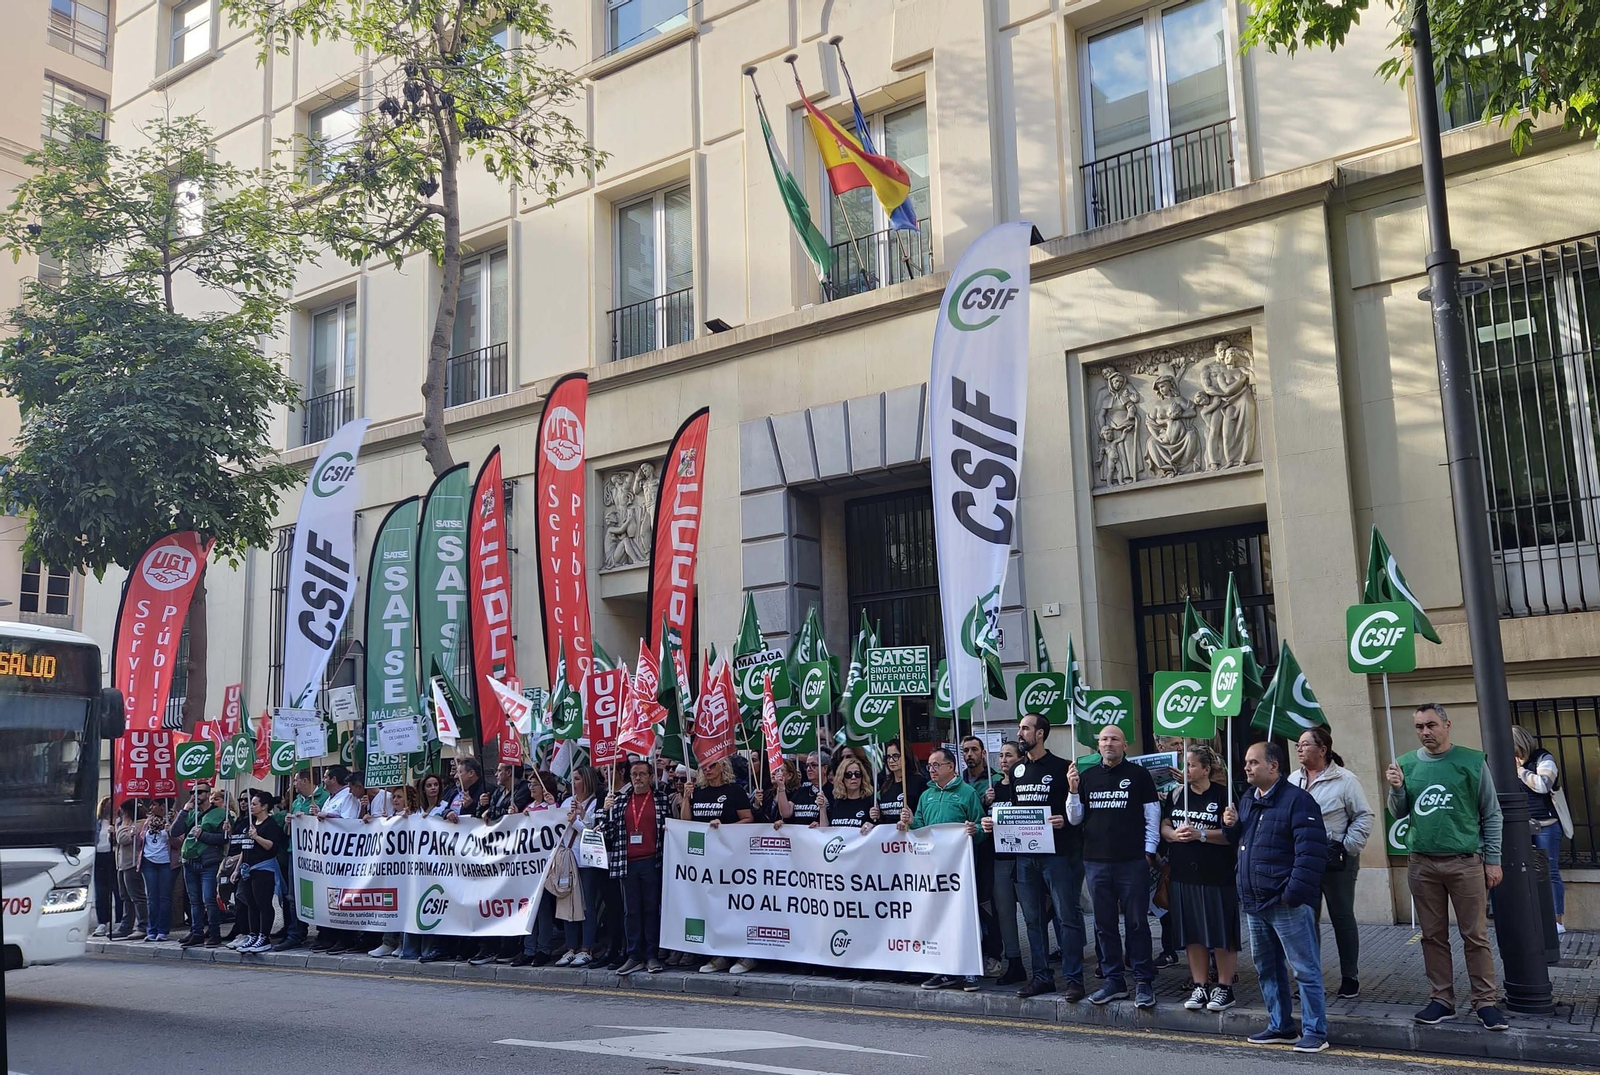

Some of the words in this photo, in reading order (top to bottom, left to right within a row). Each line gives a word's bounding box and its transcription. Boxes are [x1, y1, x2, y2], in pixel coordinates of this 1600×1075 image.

[962, 287, 1019, 310] CSIF
[951, 376, 1017, 546] CSIF
[322, 465, 356, 482] CSIF
[435, 519, 463, 529] SATSE
[151, 551, 192, 574] UGT
[383, 551, 409, 560] SATSE
[298, 529, 350, 650] CSIF
[382, 567, 411, 704] SATSE
[1361, 627, 1406, 647] CSIF
[125, 600, 151, 729] Servici
[738, 651, 782, 668] MALAGA
[870, 649, 926, 666] SATSE
[148, 605, 177, 728] Públic
[870, 666, 912, 674] SINDICATO
[871, 673, 926, 681] ENFERMERIA
[1217, 672, 1238, 690] CSIF
[806, 681, 826, 695] CSIF
[871, 681, 927, 693] MALAGA
[862, 698, 895, 714] CSIF
[1027, 691, 1061, 705] CSIF
[1167, 694, 1208, 713] CSIF
[226, 688, 240, 732] UGT
[594, 675, 617, 738] UGT
[564, 708, 578, 722] SIF
[1091, 709, 1127, 724] CSIF
[784, 721, 811, 736] CSIF
[130, 732, 149, 778] UGT
[153, 733, 171, 778] UGT
[183, 754, 211, 765] CSIF
[223, 754, 235, 766] CSIF
[238, 746, 249, 759] CSIF
[1016, 784, 1050, 793] CONSEJERA
[1089, 791, 1129, 800] CONSEJERA
[831, 818, 862, 826] CONSEJERA
[1172, 809, 1218, 822] CONSEJERA
[297, 828, 313, 853] LOS
[315, 831, 383, 857] ACUERDOS
[386, 830, 415, 856] SON
[418, 830, 459, 856] PARA
[461, 823, 566, 857] CUMPLIRLOS
[881, 842, 907, 854] UGT
[827, 843, 846, 855] CSIF
[297, 856, 324, 876] CONSEJERA,
[325, 860, 361, 877] CUMPLE
[360, 863, 367, 876] EL
[368, 861, 406, 876] ACUERDO
[408, 861, 414, 876] DE
[415, 861, 453, 877] PRIMARIA
[455, 862, 460, 877] Y
[461, 863, 499, 878] CARRERA
[500, 858, 548, 877] PROFESIO
[675, 864, 697, 882] NO
[701, 868, 713, 884] A
[720, 869, 757, 885] LOS
[764, 869, 845, 891] RECORTES
[851, 873, 960, 892] SALARIALES
[422, 898, 448, 914] CSIF
[479, 899, 514, 918] UGT
[728, 894, 754, 910] NO
[760, 895, 781, 912] AL
[787, 897, 828, 917] ROBO
[833, 901, 869, 918] DEL
[875, 901, 912, 919] CRP
[833, 939, 852, 948] CSIF
[888, 939, 910, 951] UGT
